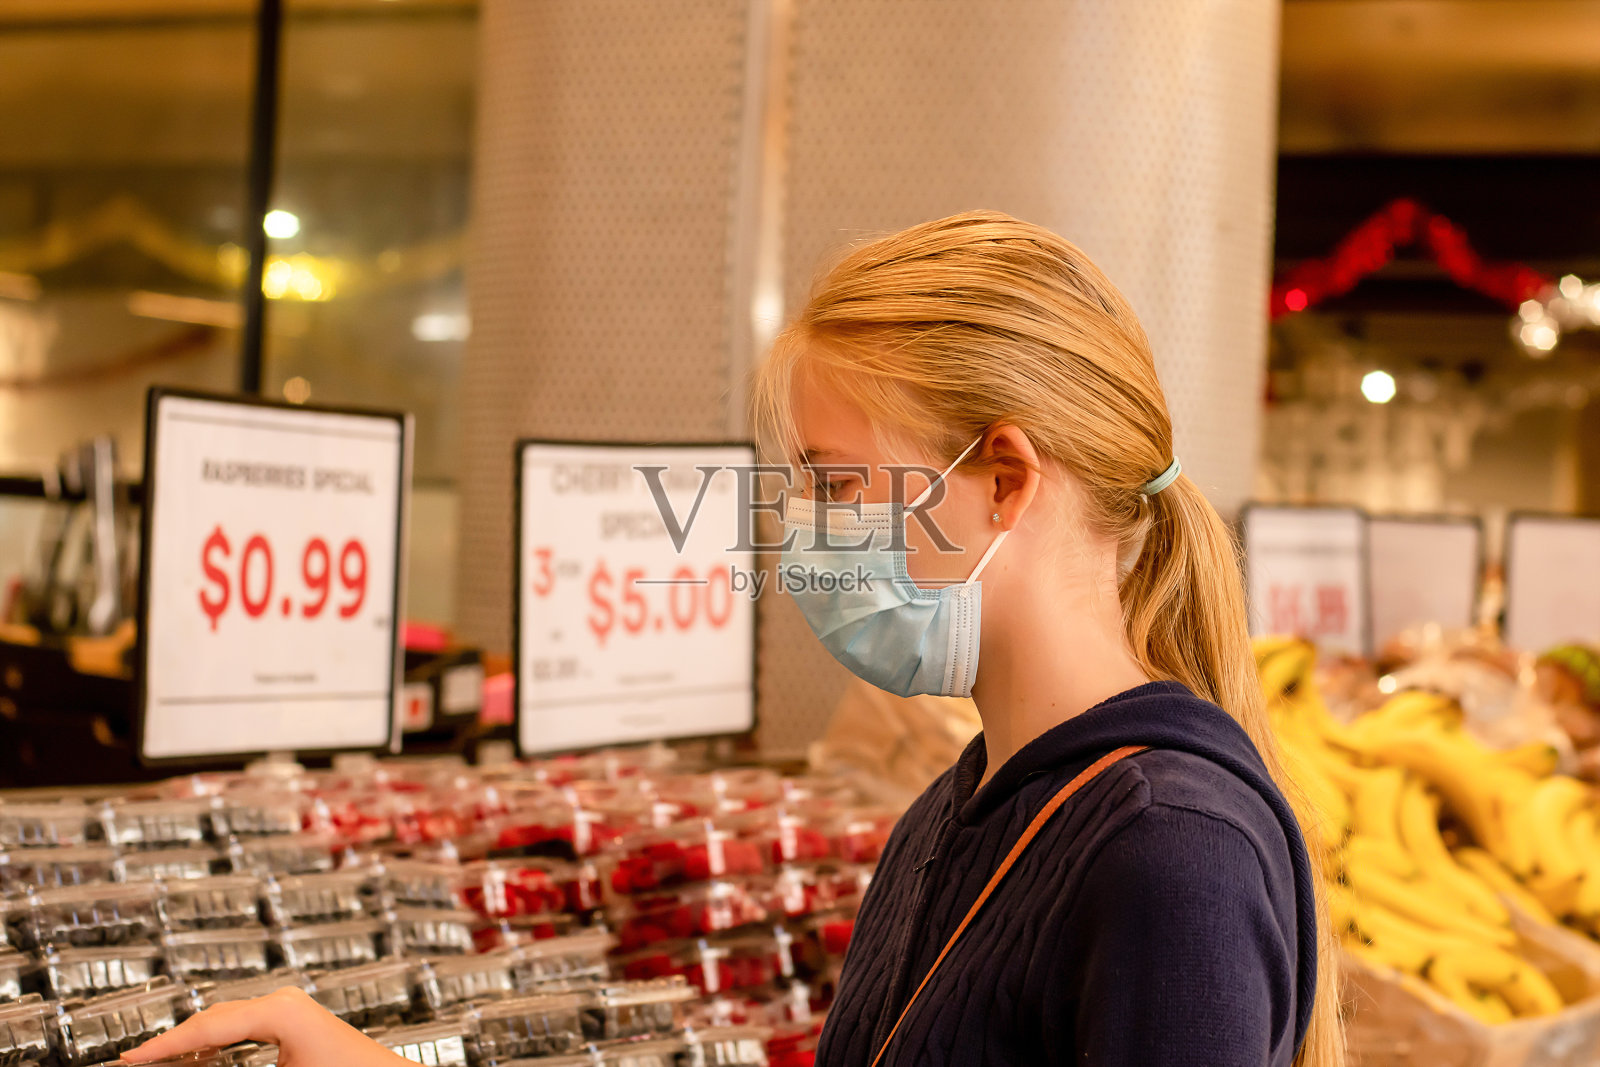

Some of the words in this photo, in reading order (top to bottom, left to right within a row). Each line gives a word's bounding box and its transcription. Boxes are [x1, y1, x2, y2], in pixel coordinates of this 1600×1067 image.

[198, 523, 368, 634] $0.99
[533, 546, 555, 599] 3
[587, 555, 733, 649] $5.00
